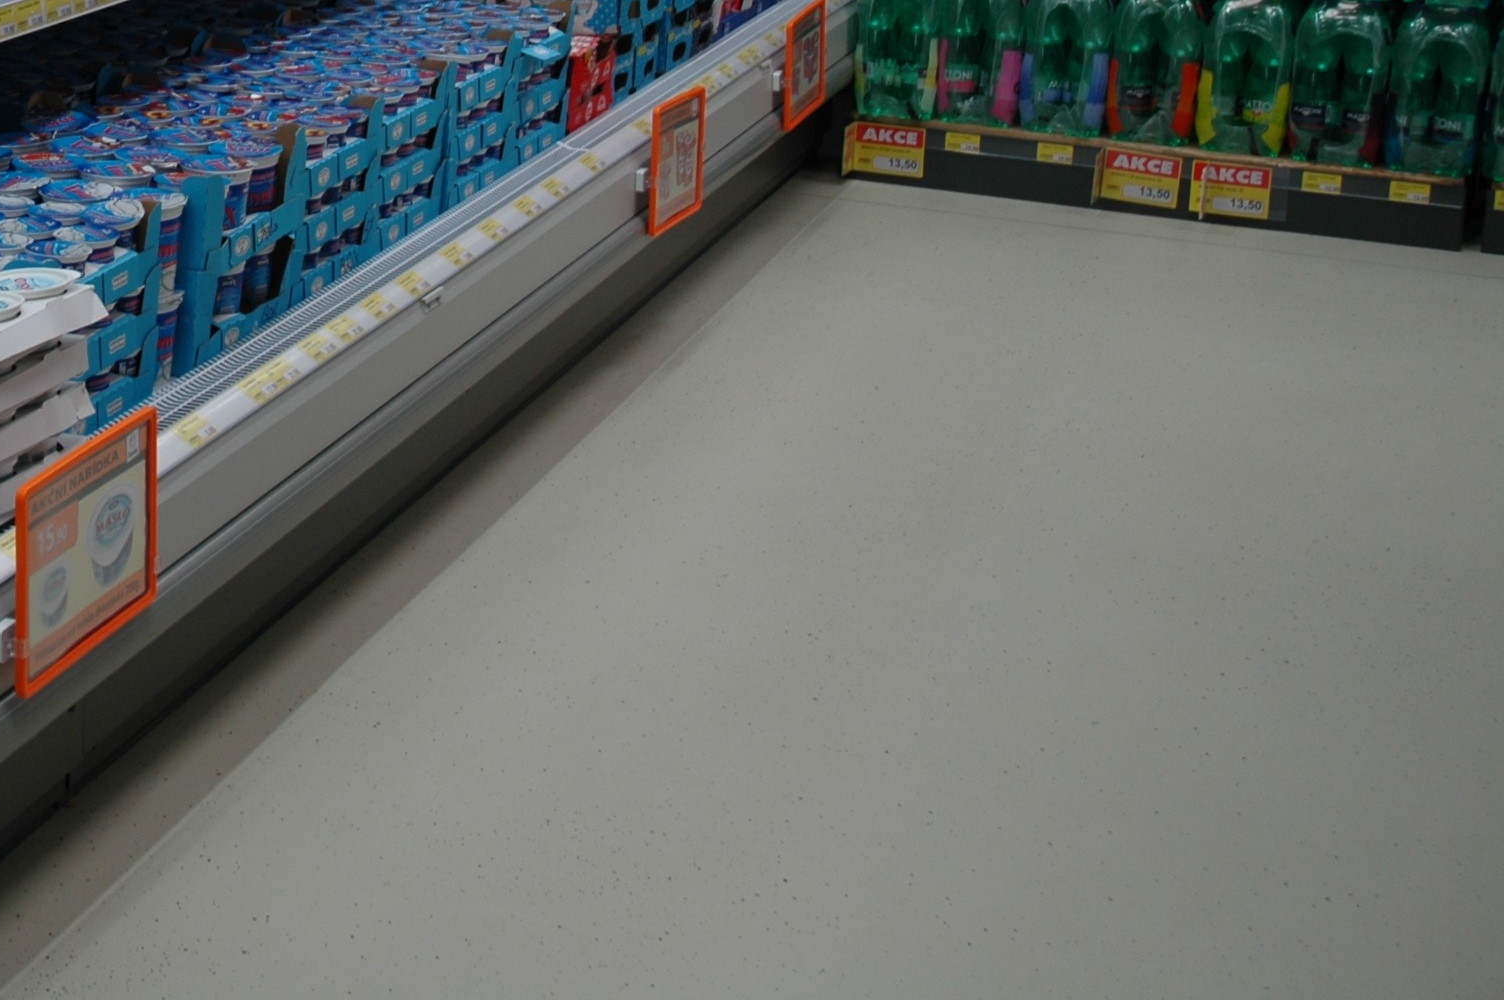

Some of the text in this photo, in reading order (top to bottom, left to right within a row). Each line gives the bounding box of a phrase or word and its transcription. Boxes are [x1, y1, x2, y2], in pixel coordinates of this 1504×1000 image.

[862, 127, 918, 146] AKCE
[886, 157, 918, 171] 13,50
[1113, 154, 1173, 175] AKCE
[1201, 165, 1263, 186] AKCE
[1138, 186, 1171, 201] 13,50
[1230, 197, 1263, 213] 13,50
[69, 450, 121, 491] NABÍDKA
